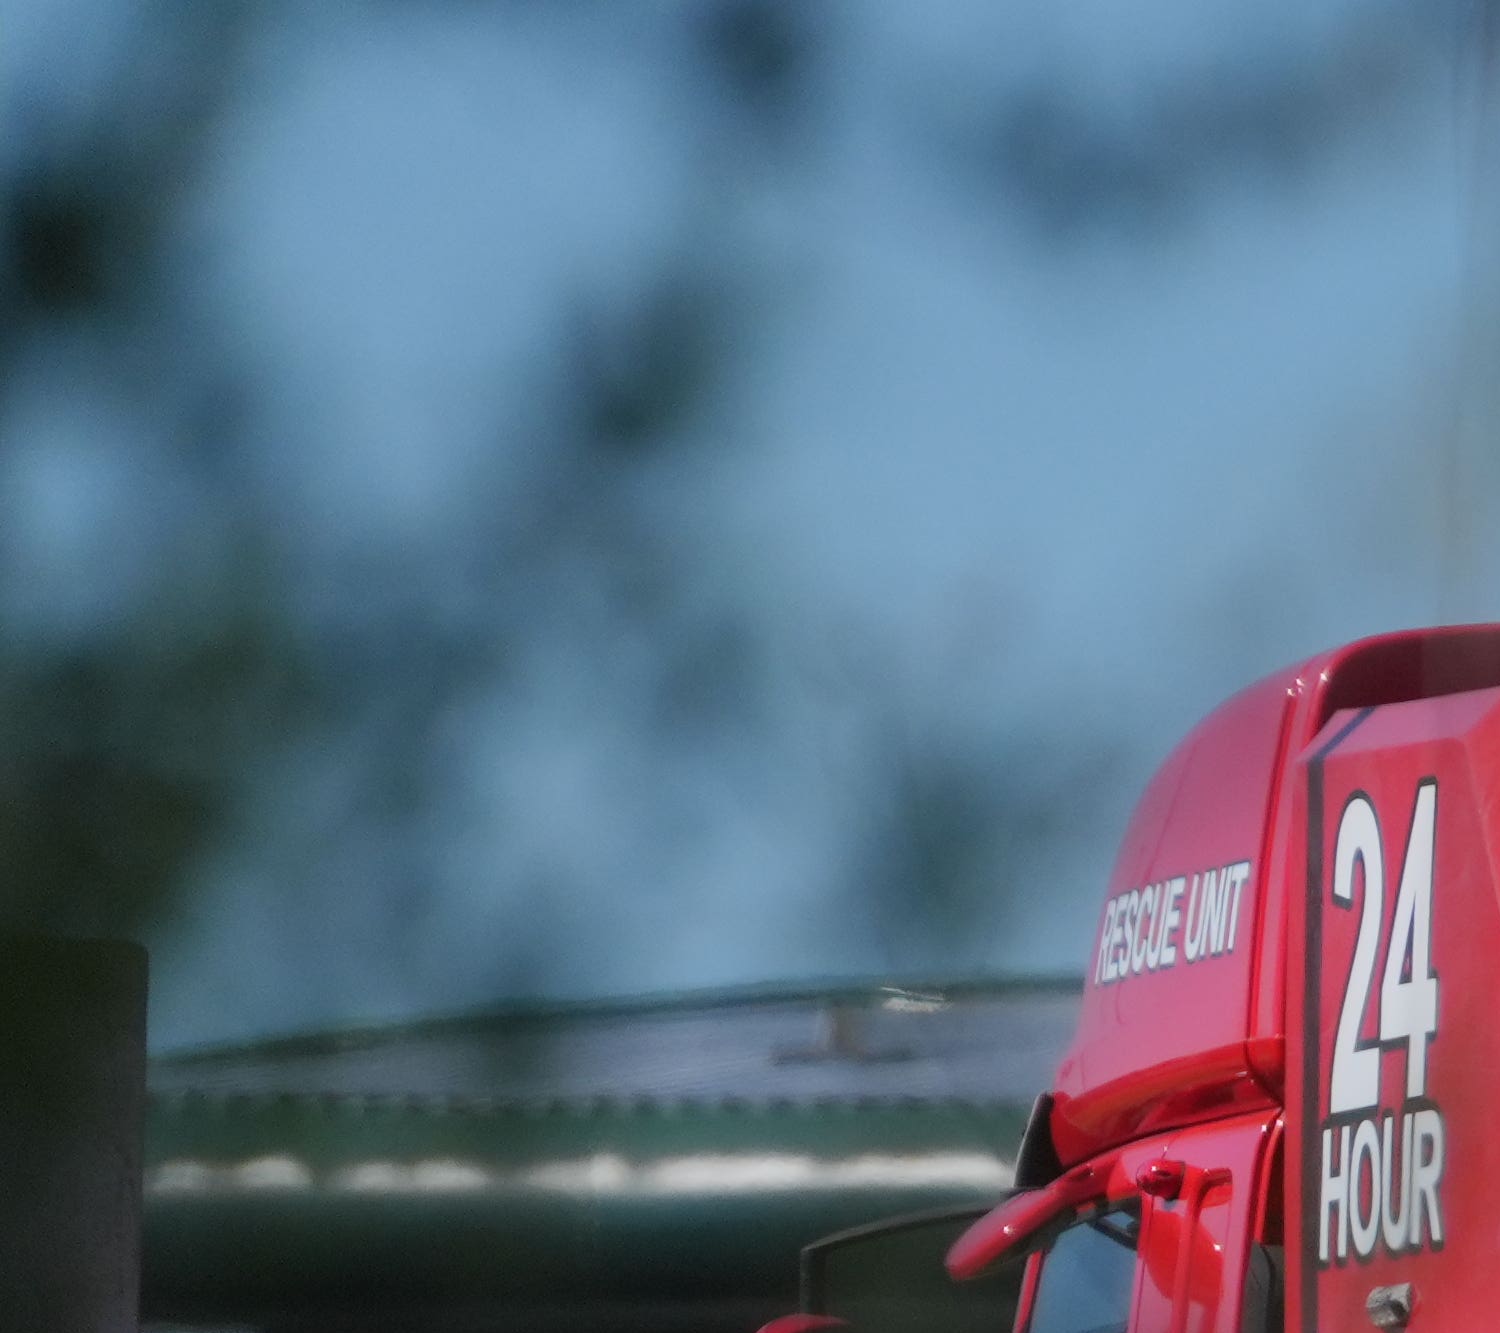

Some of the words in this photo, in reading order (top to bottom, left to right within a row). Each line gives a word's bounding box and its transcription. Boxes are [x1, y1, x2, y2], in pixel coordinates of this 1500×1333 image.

[1094, 874, 1185, 986] RESCUE
[1183, 859, 1250, 963] UNIT
[1332, 777, 1439, 1116] 24
[1318, 1107, 1446, 1270] HOUR
